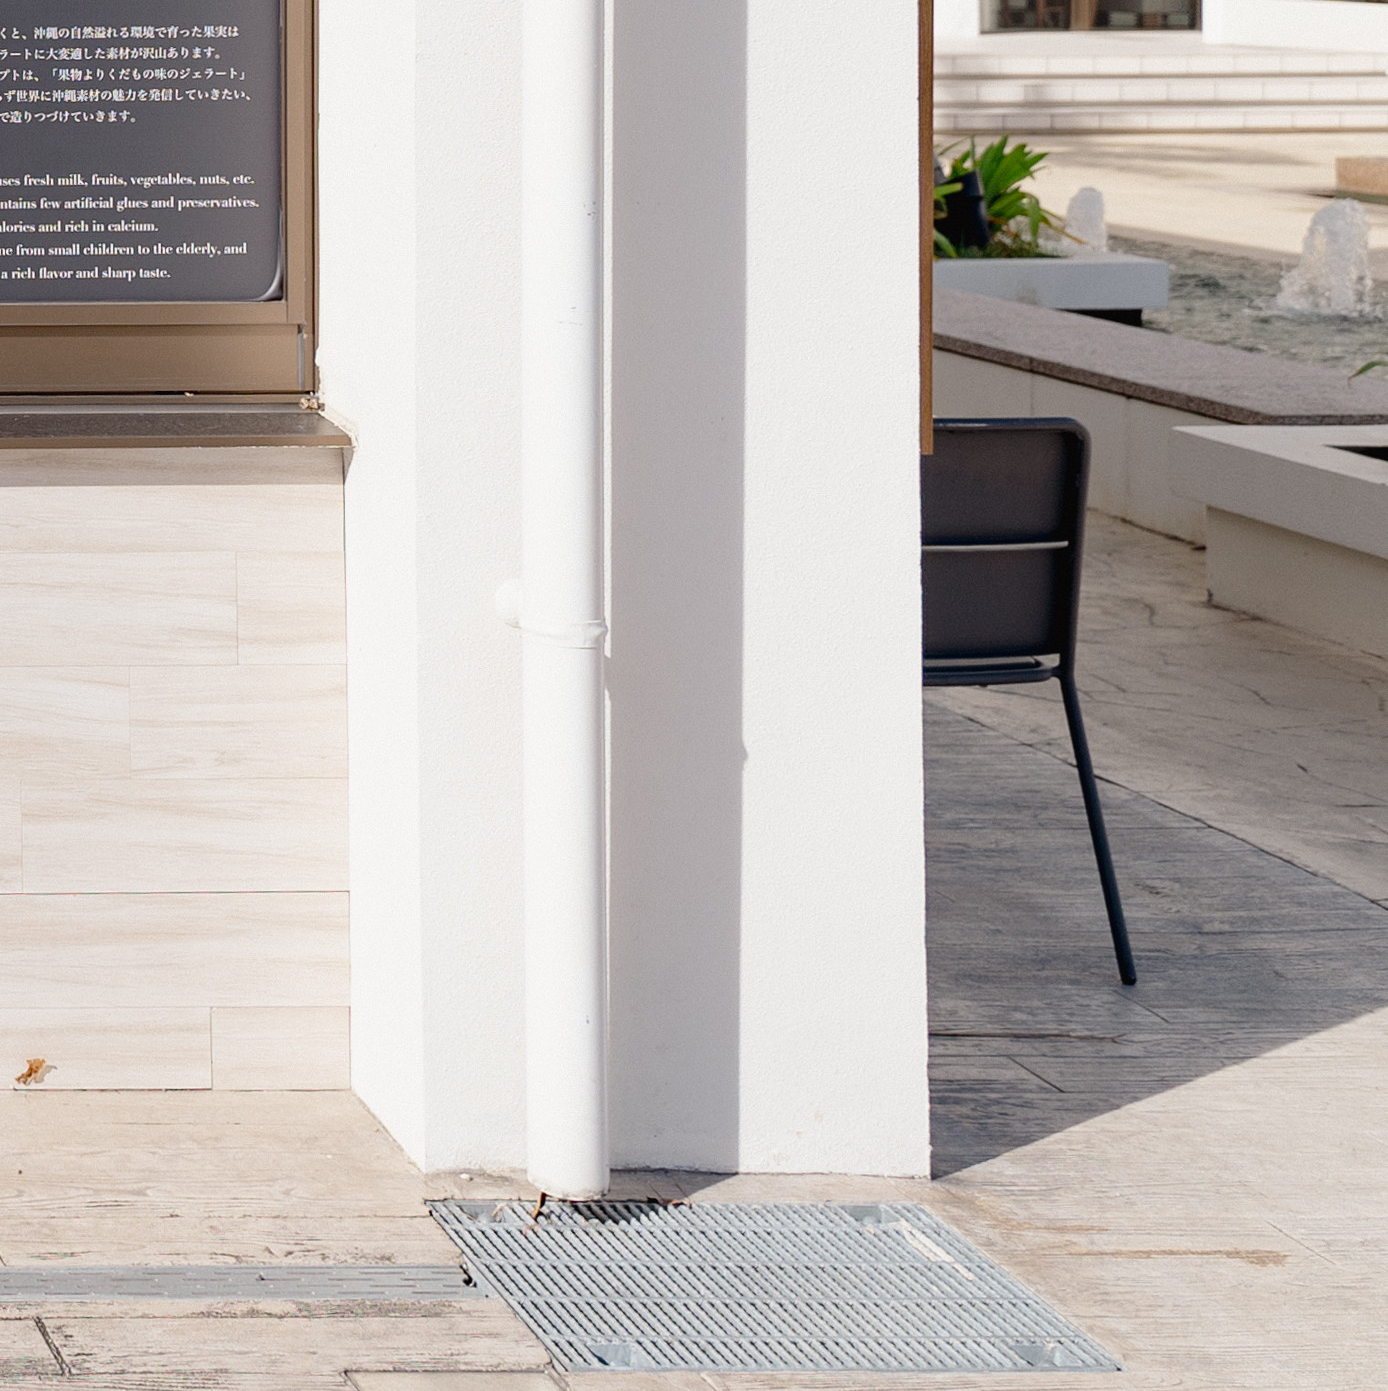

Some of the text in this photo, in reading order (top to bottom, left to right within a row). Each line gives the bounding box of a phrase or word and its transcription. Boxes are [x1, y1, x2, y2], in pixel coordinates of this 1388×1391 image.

[24, 174, 54, 186] fresh
[57, 174, 88, 187] milk,
[91, 174, 128, 186] fruits,
[130, 173, 196, 189] vegetables,
[199, 174, 230, 185] nuts,
[233, 175, 255, 185] etc.
[40, 197, 61, 209] few
[64, 197, 113, 209] artificial
[116, 197, 149, 212] glues
[151, 197, 174, 208] and
[177, 196, 260, 211] preservatives.
[38, 220, 61, 233] and
[64, 220, 89, 232] rich
[92, 220, 105, 232] in
[107, 220, 159, 232] calcium.
[16, 244, 45, 256] from
[48, 243, 80, 255] small
[83, 243, 134, 255] children
[137, 244, 150, 255] to
[153, 243, 173, 255] the
[175, 243, 221, 258] elderly,
[224, 242, 247, 254] and
[1, 270, 8, 279] a
[11, 267, 35, 279] rich
[39, 267, 73, 279] flavor
[76, 267, 99, 279] and
[101, 266, 136, 282] sharp
[139, 267, 171, 278] taste.
